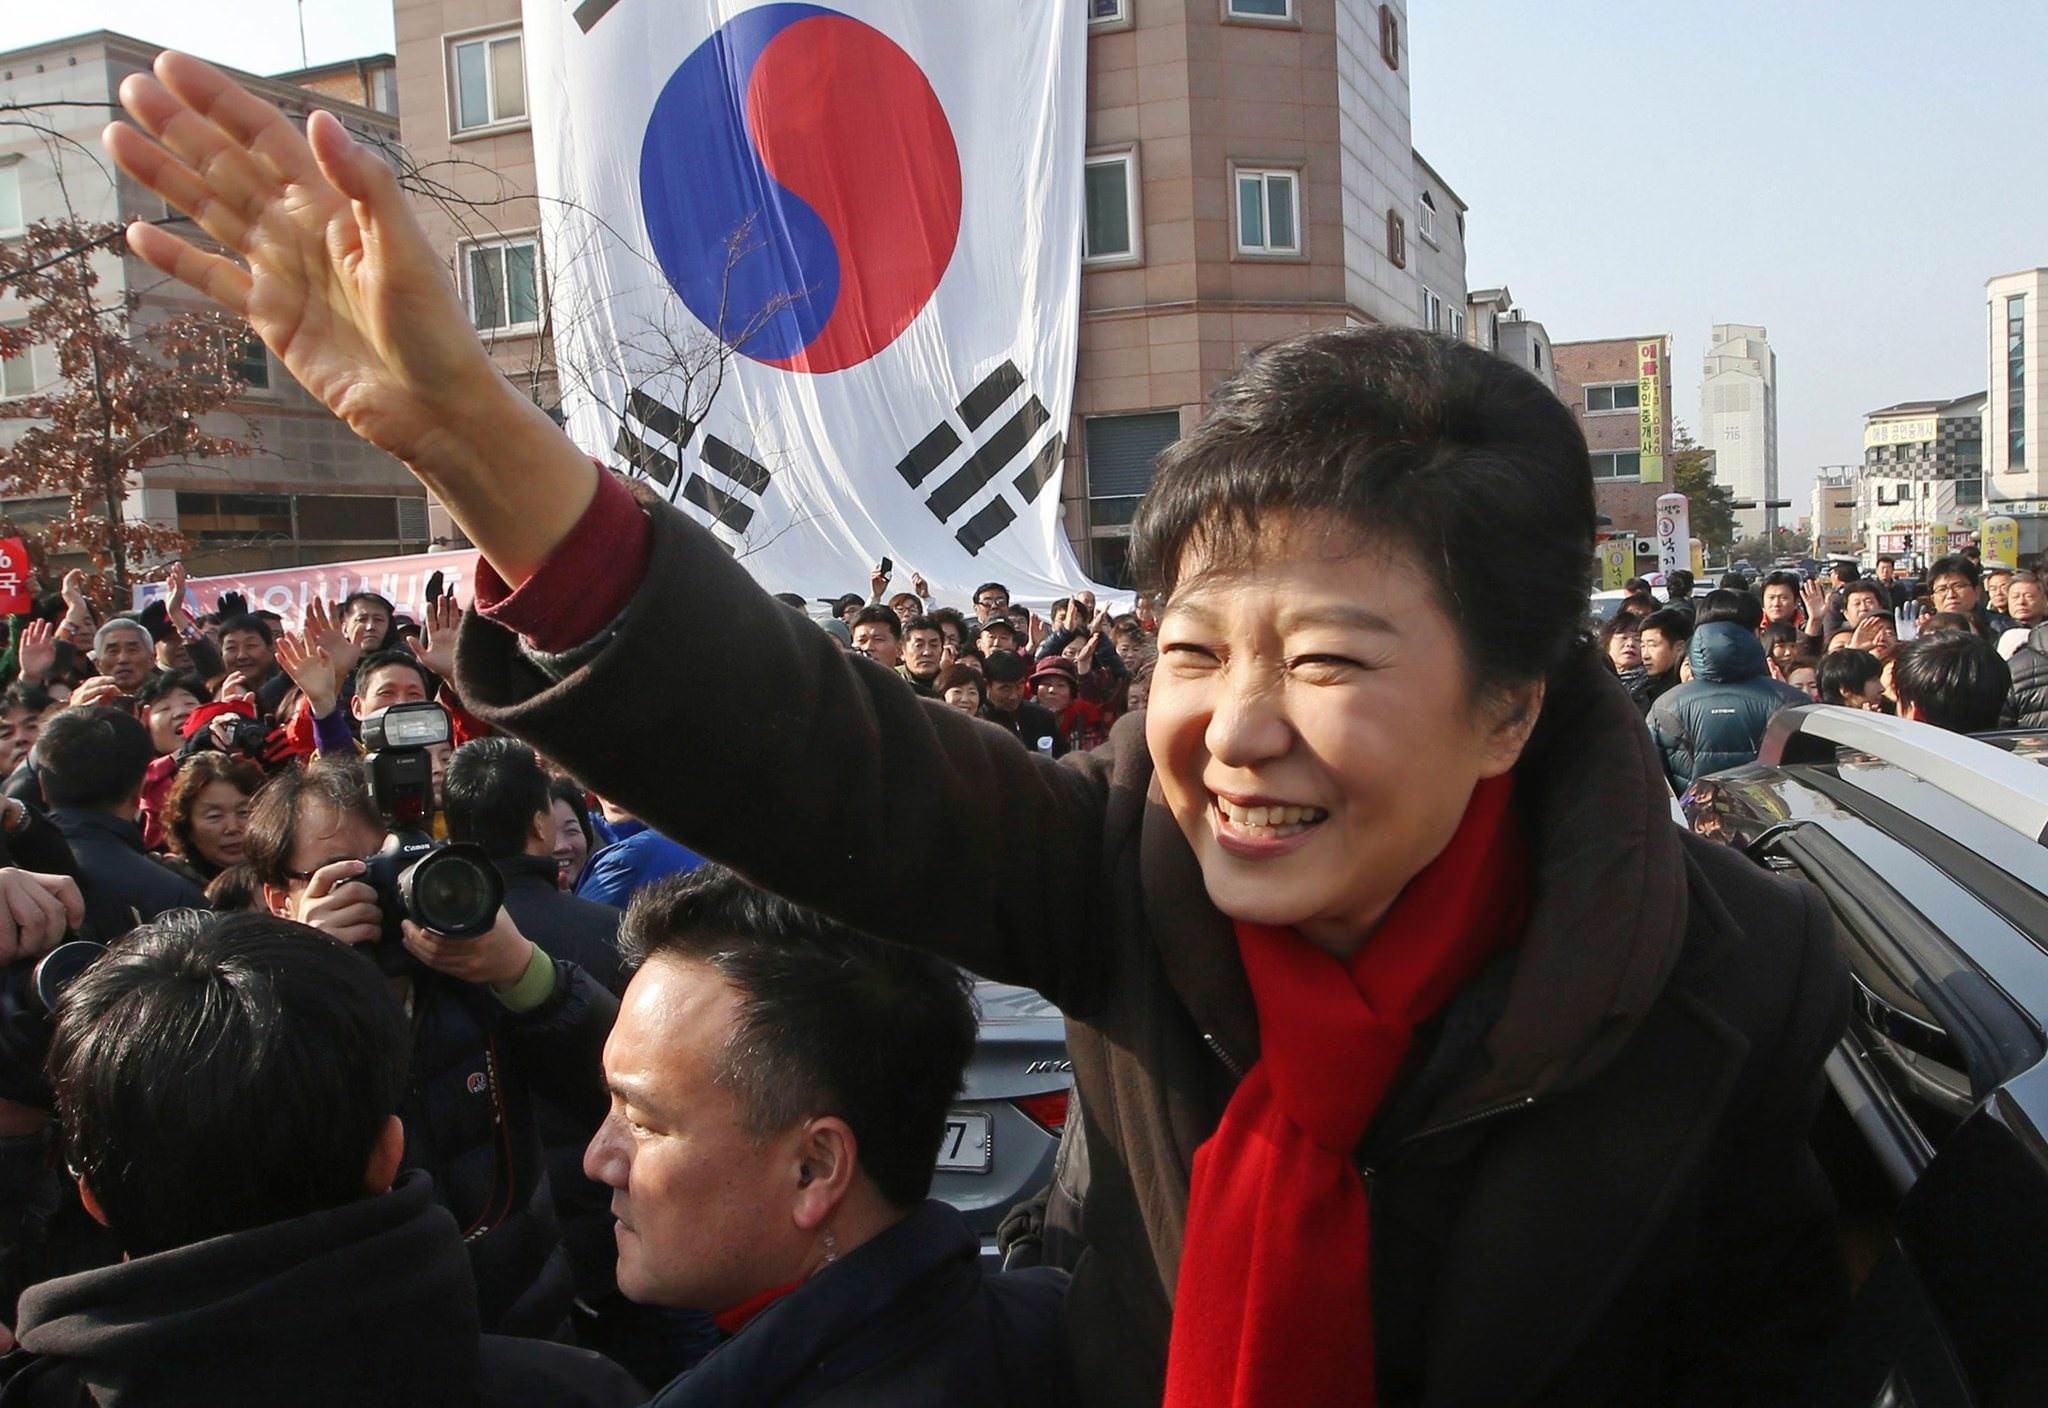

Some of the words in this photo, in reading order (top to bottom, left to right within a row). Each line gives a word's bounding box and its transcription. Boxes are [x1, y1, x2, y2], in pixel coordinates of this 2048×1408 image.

[1640, 377, 1652, 454] 공인중개사
[1724, 431, 1740, 440] 715
[403, 843, 431, 852] Canon
[946, 1122, 967, 1159] 7
